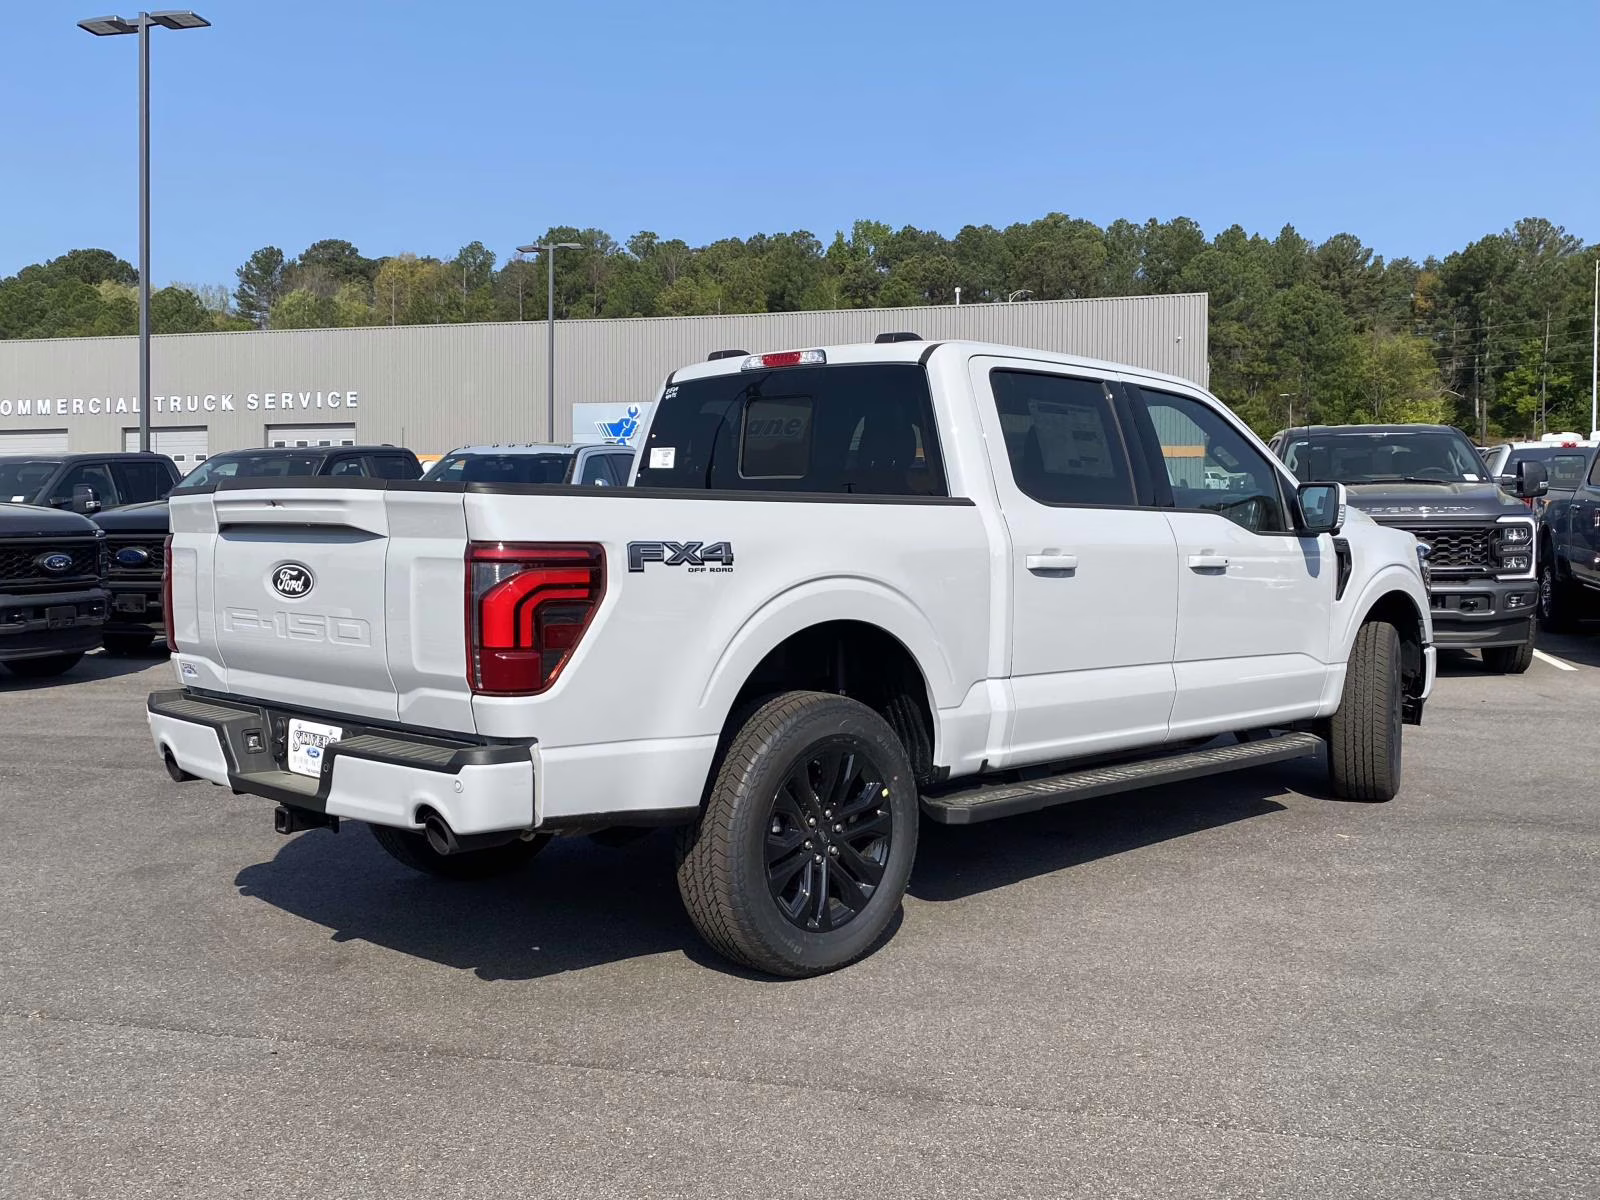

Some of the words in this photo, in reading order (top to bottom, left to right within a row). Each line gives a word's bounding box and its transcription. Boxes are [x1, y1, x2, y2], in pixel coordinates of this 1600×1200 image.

[154, 395, 235, 412] TRUCK
[247, 391, 359, 410] SERVICE
[750, 417, 803, 437] ane
[627, 541, 734, 573] FX4
[276, 568, 306, 593] Ford
[223, 606, 372, 647] F-150
